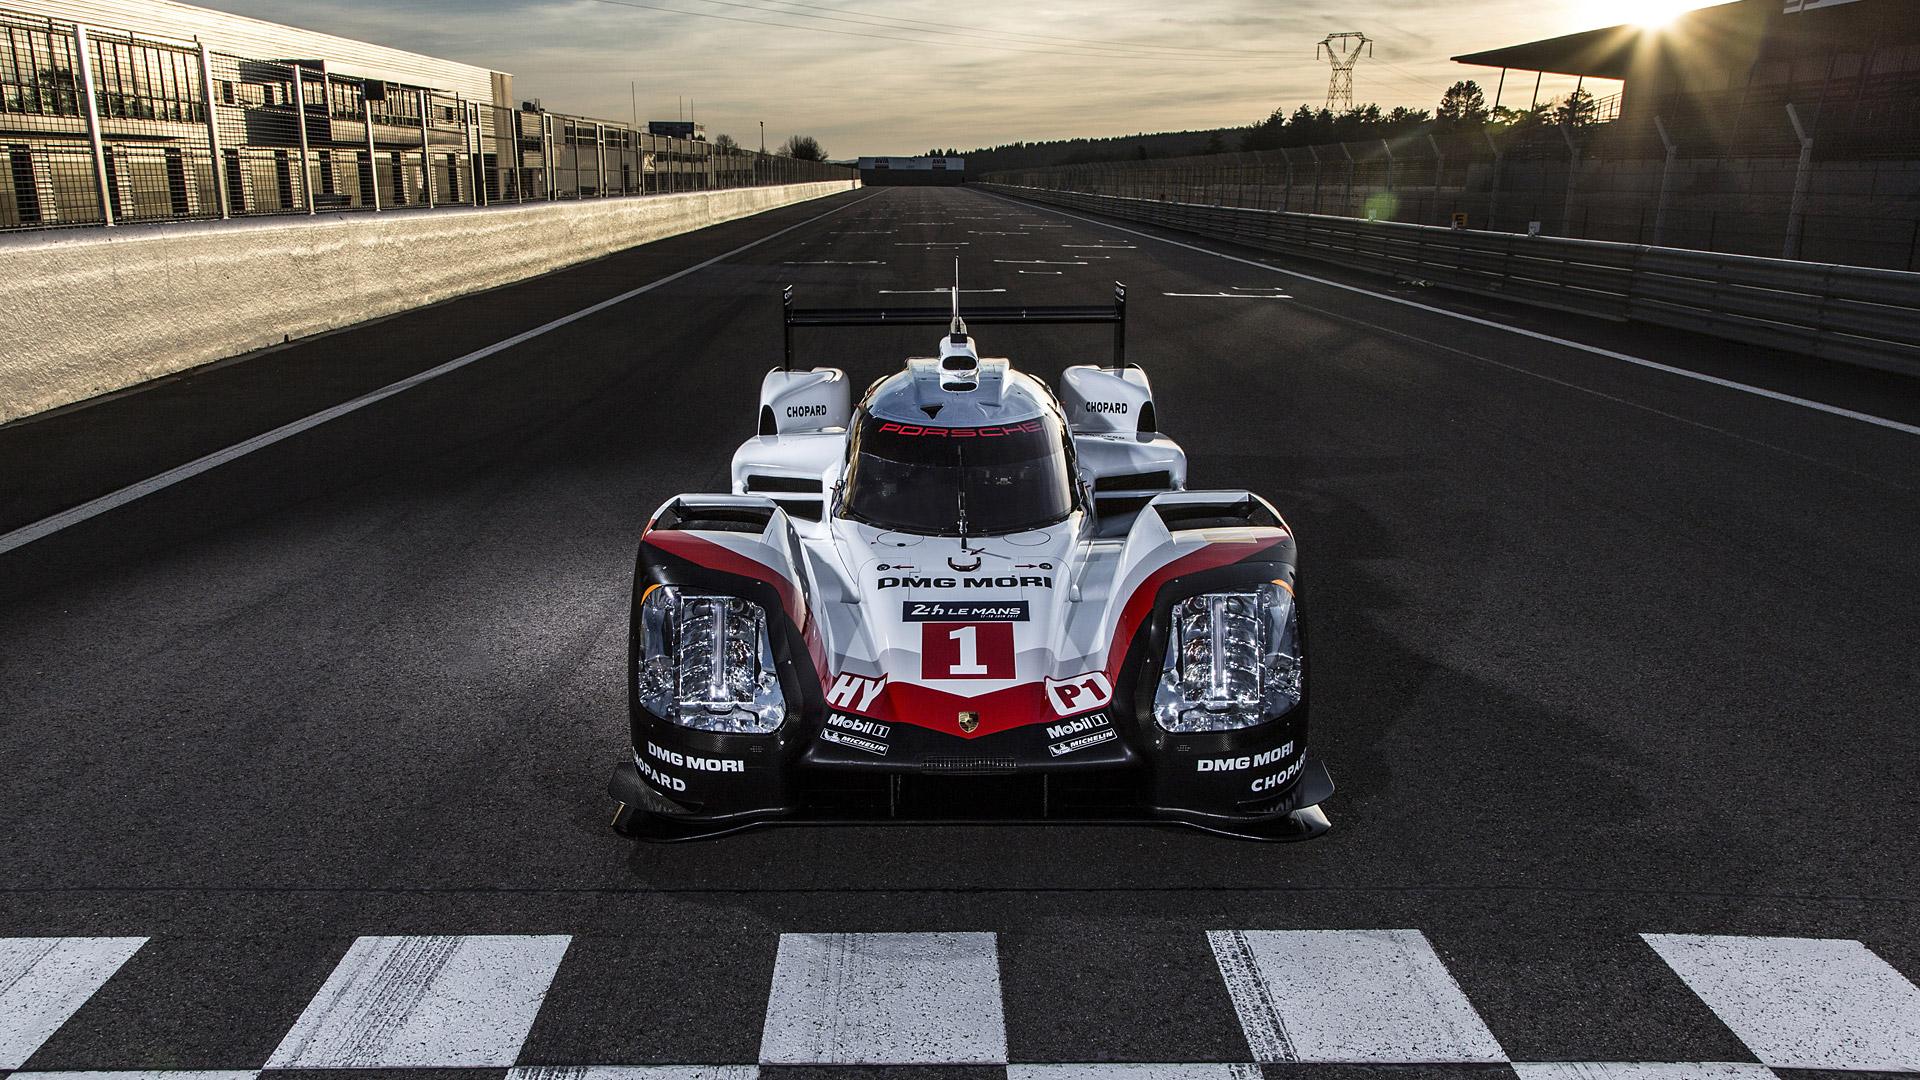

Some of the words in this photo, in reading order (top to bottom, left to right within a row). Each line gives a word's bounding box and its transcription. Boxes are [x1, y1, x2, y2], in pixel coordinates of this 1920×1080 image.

[787, 405, 827, 417] CHOPARD
[1086, 401, 1128, 414] CHOPARD
[878, 422, 1044, 438] PORSCHE
[878, 577, 956, 590] DMG
[964, 576, 1052, 589] MORI
[971, 607, 1021, 615] MANS
[949, 626, 988, 675] 1
[826, 674, 887, 712] HY
[1054, 679, 1107, 709] P1
[827, 713, 874, 734] Mobil
[1046, 717, 1093, 739] Mobil
[841, 736, 886, 752] MICHELIN
[1070, 731, 1113, 748] MICHELIN
[648, 741, 683, 766] DMG
[686, 756, 744, 772] MORI
[1197, 757, 1250, 772] DMG
[1253, 740, 1293, 768] MORI
[633, 746, 686, 792] HOPARD
